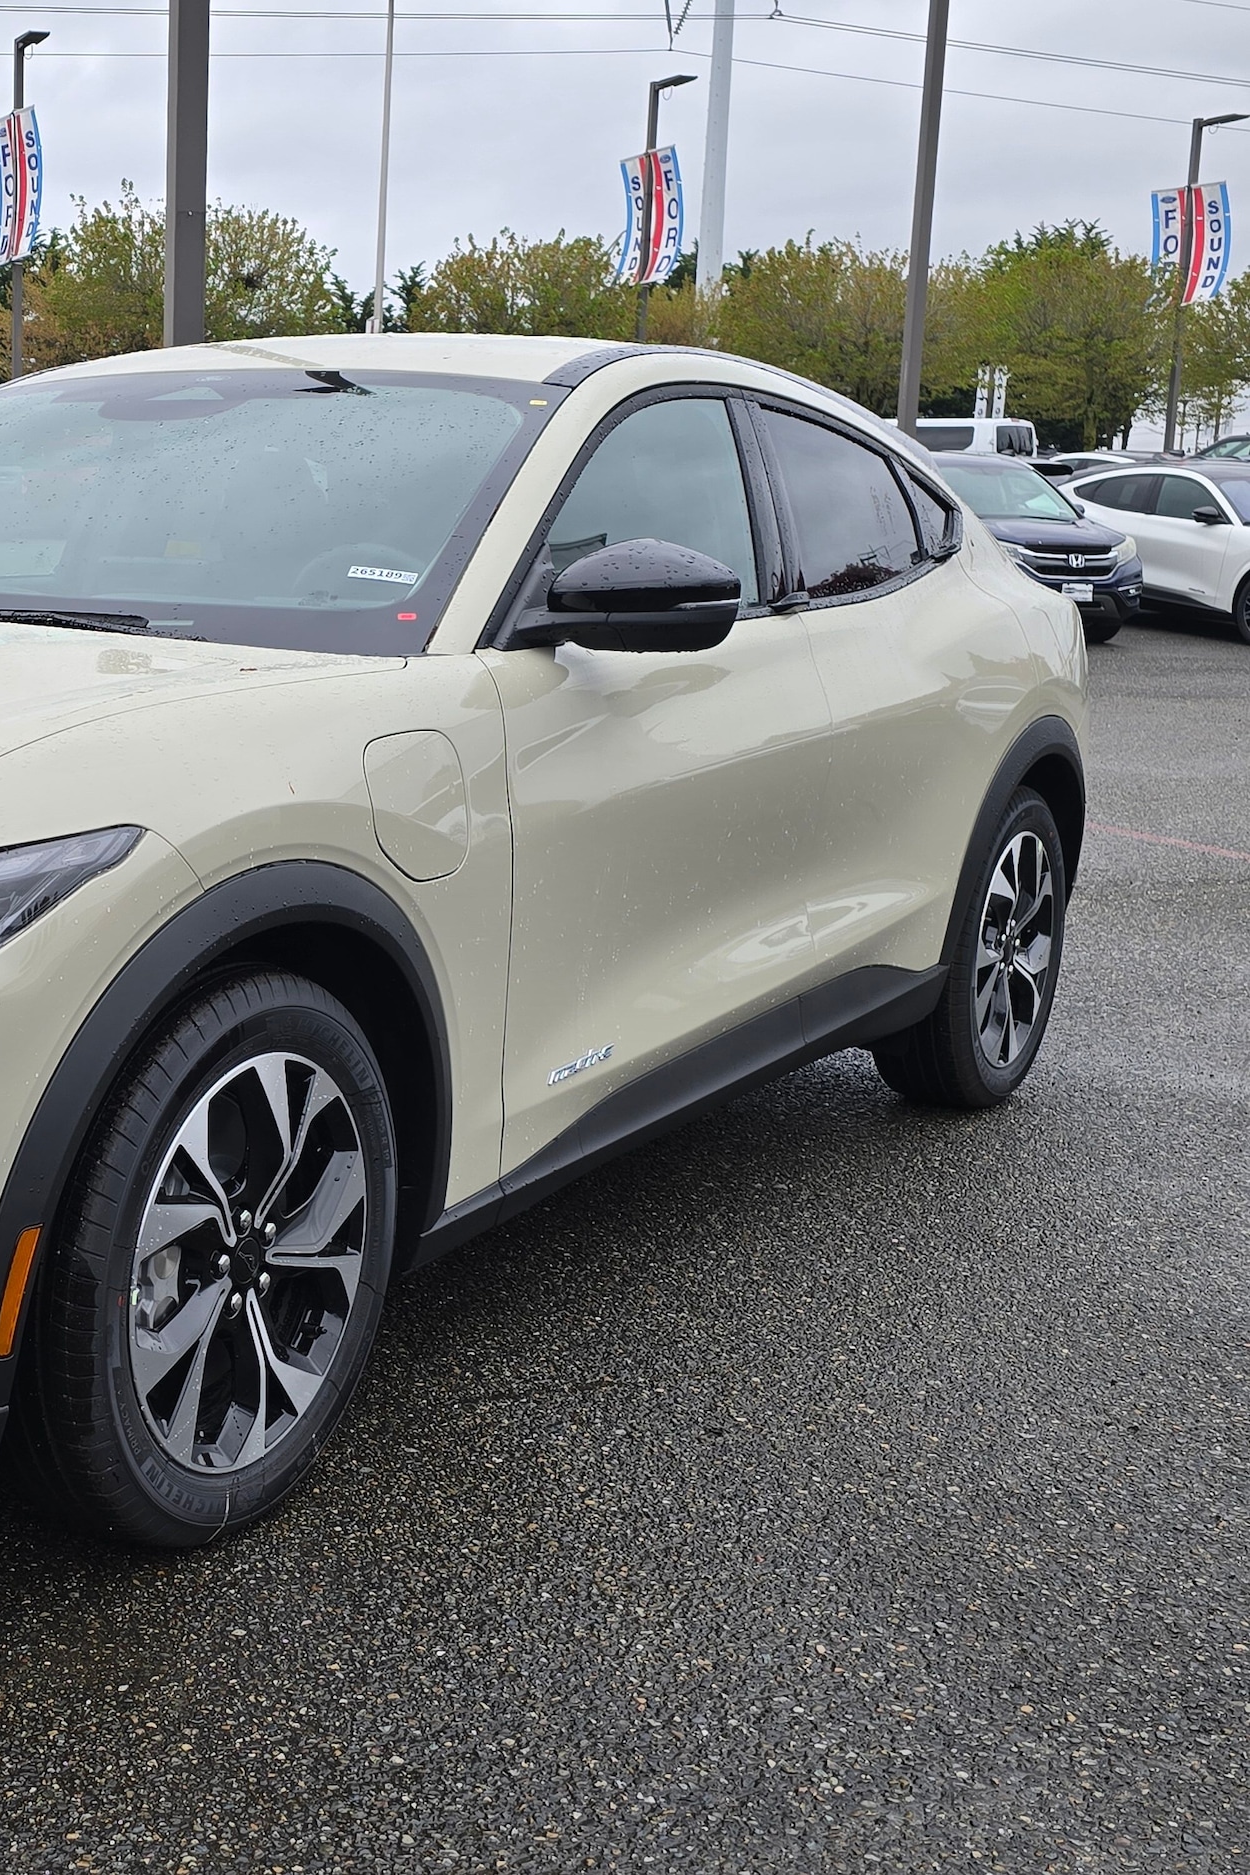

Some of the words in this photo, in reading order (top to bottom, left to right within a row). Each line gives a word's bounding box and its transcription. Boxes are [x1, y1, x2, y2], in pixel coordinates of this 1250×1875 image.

[25, 131, 39, 238] SOUND
[655, 169, 679, 273] FORD
[1201, 200, 1223, 289] SOUND
[350, 567, 403, 580] 265189
[119, 1402, 140, 1456] PRIMACY
